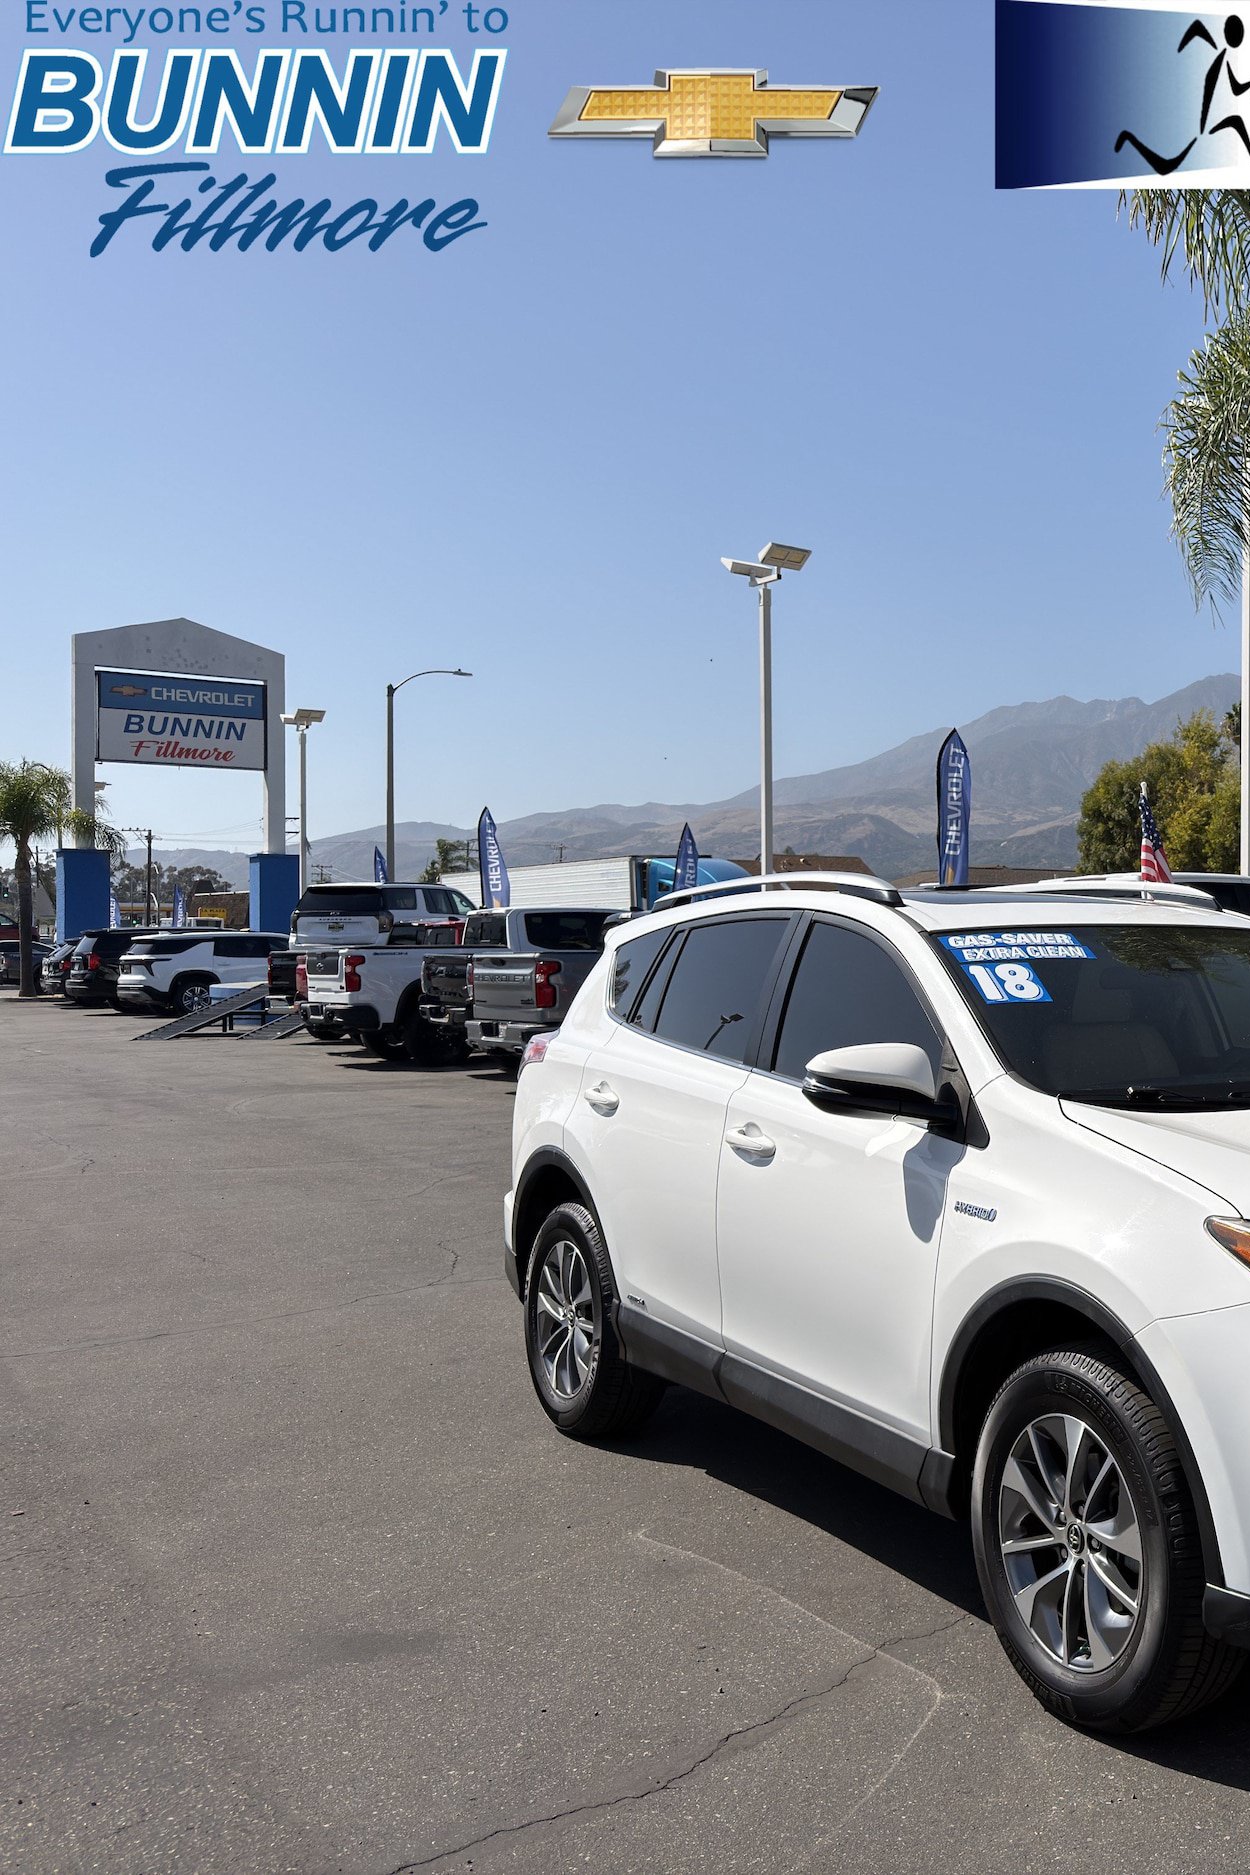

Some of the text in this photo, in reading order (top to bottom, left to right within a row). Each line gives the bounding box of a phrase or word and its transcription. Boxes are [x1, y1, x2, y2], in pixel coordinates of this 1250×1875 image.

[151, 687, 255, 707] CHEVROLET
[123, 714, 247, 741] BUNNIN
[129, 740, 236, 762] Fillmore
[945, 743, 965, 856] CHEVROLET
[948, 933, 1075, 948] GAS-SAVER
[962, 945, 1088, 962] EXTRA CLEAN
[968, 963, 1044, 1001] 18
